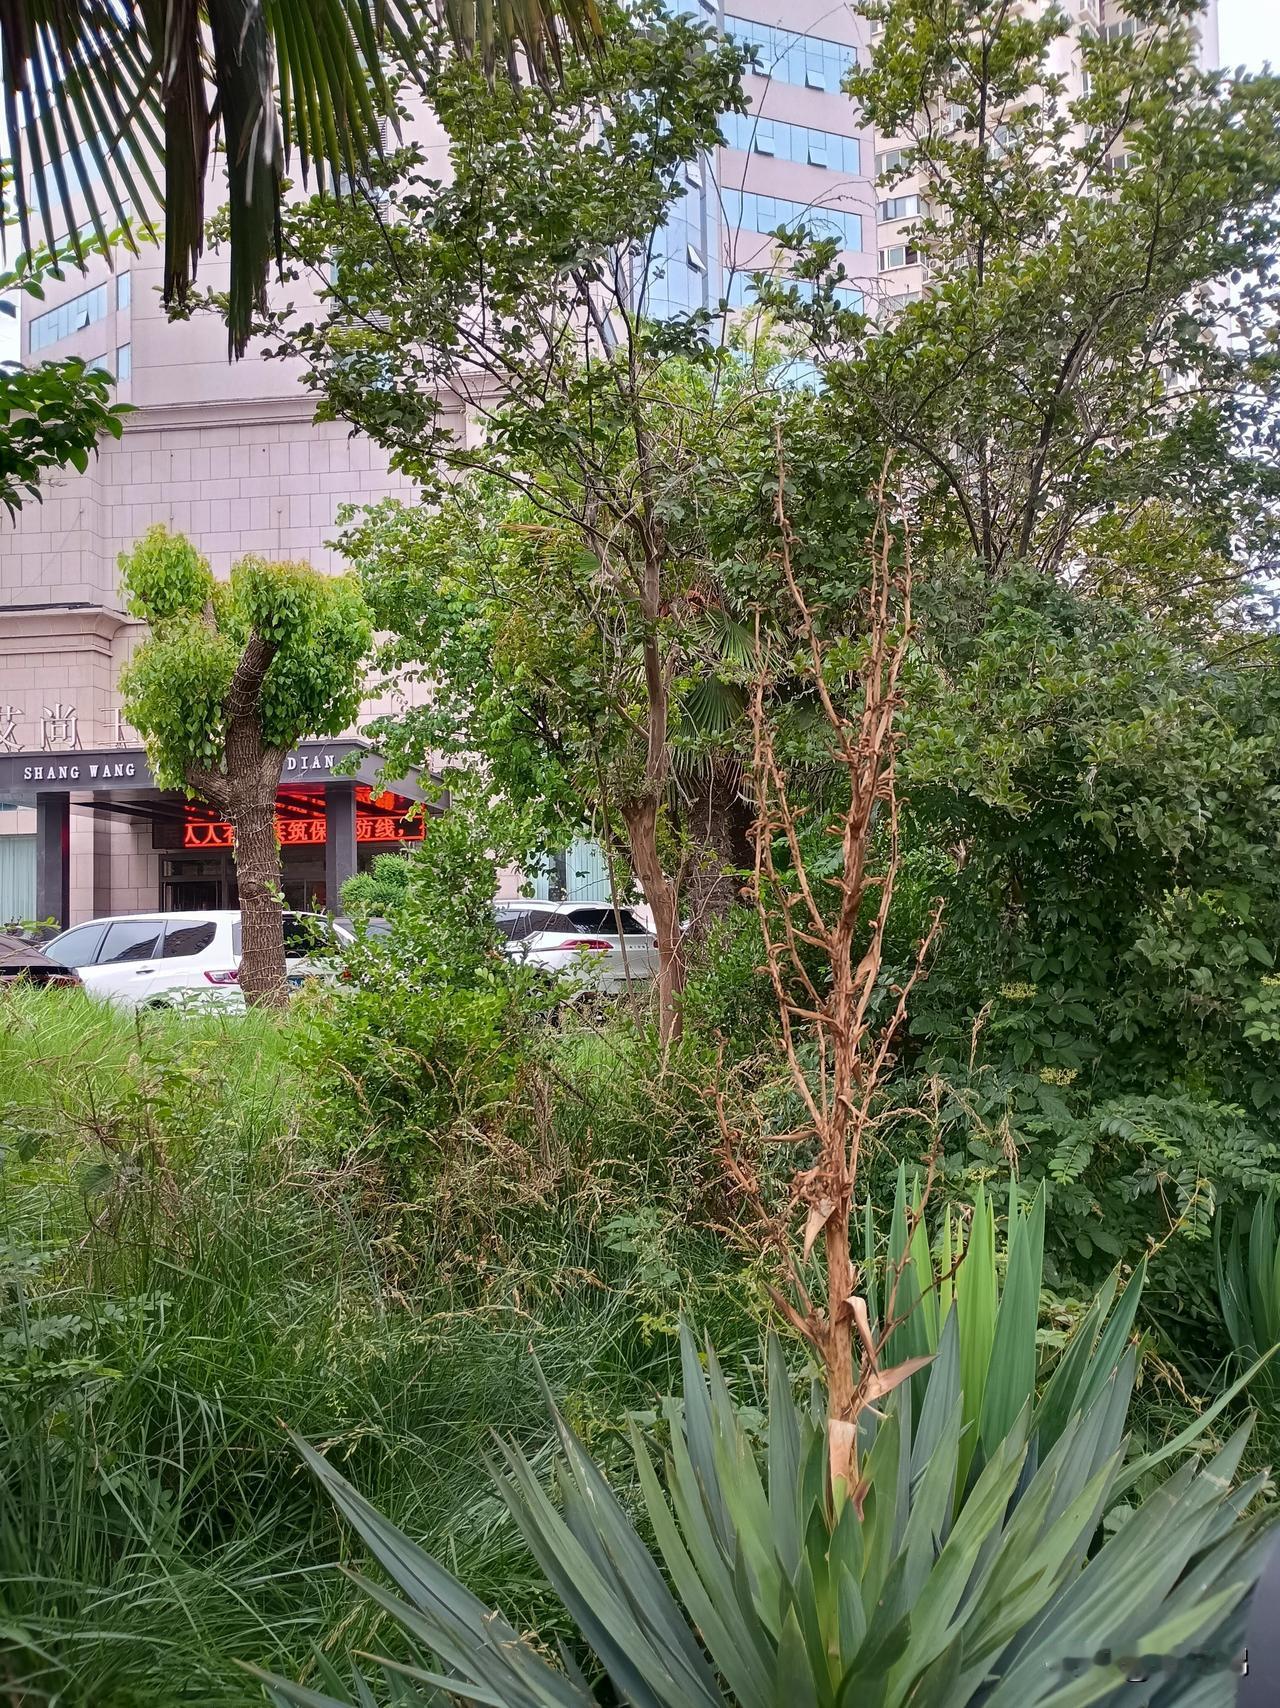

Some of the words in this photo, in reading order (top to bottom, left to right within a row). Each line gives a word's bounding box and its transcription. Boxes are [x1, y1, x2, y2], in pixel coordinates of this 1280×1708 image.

[23, 766, 80, 780] SHANG
[89, 763, 136, 778] WANG
[287, 755, 335, 770] DIAN
